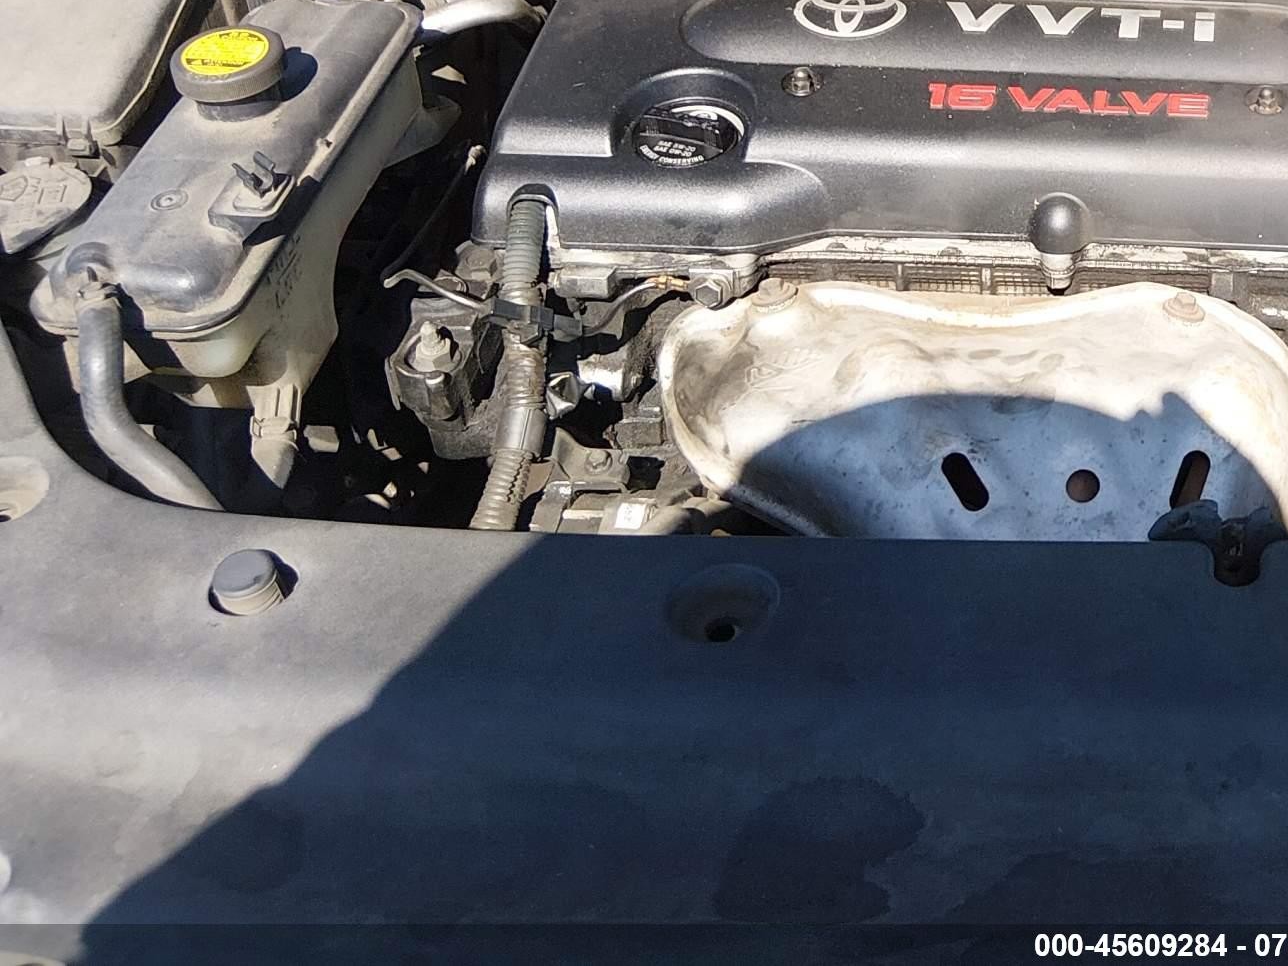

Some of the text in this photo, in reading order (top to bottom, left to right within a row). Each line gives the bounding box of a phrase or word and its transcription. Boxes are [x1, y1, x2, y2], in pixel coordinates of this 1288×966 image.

[946, 1, 1216, 42] VVT-i
[928, 83, 1210, 118] 16 VALVE
[659, 155, 704, 165] CONSERVING
